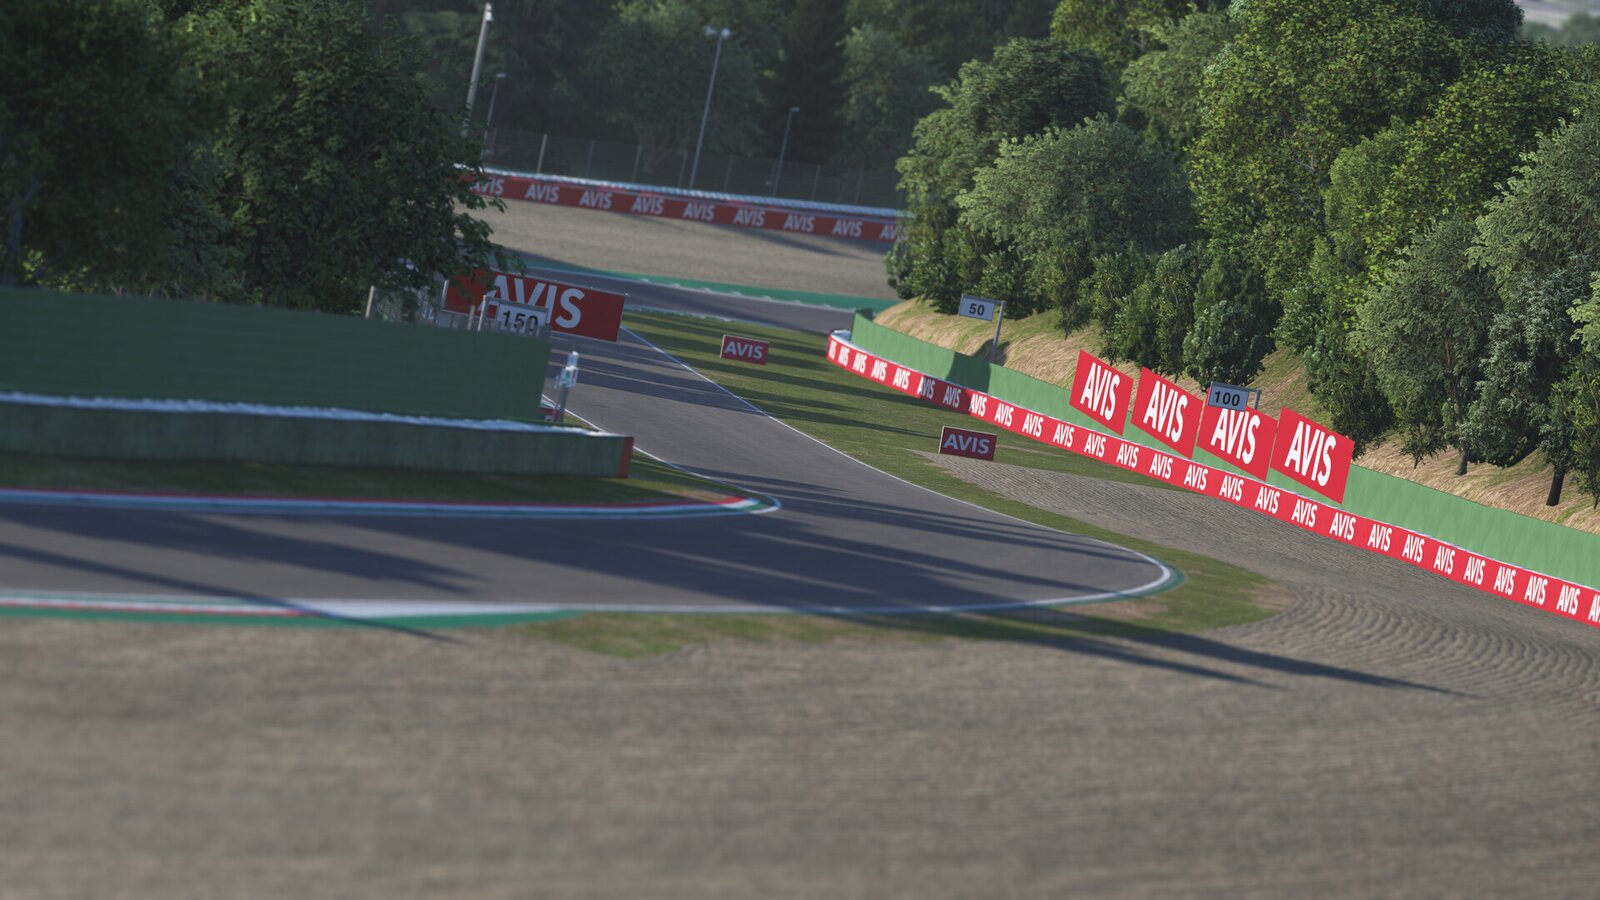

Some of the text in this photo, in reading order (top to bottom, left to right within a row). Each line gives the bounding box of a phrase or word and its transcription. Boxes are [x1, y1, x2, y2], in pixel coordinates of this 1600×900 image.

[525, 184, 560, 202] AVIS
[579, 190, 612, 209] AVIS
[631, 196, 665, 215] AVIS
[683, 202, 715, 221] AVIS
[733, 207, 765, 226] AVIS
[783, 214, 815, 232] AVIS
[832, 219, 863, 237] AVIS
[477, 275, 585, 329] AVIS
[969, 303, 985, 316] 50
[724, 341, 764, 359] AVIS
[1080, 362, 1121, 421] AVIS
[1143, 380, 1188, 443] AVIS
[1214, 390, 1241, 407] 100
[944, 433, 990, 455] AVIS
[1210, 408, 1261, 465] AVIS
[1284, 420, 1337, 487] AVIS
[871, 359, 888, 381] AVIS
[893, 367, 911, 390] AVIS
[917, 376, 935, 399] AVIS
[943, 385, 962, 408] AVIS
[968, 393, 987, 416] AVIS
[994, 402, 1014, 427] AVIS
[1022, 413, 1044, 437] AVIS
[1052, 423, 1075, 447] AVIS
[1084, 433, 1106, 458] AVIS
[1116, 443, 1139, 468] AVIS
[1149, 453, 1173, 479] AVIS
[1184, 464, 1208, 490] AVIS
[1219, 475, 1244, 501] AVIS
[1255, 486, 1280, 514] AVIS
[1291, 499, 1318, 528] AVIS
[1329, 512, 1356, 540] AVIS
[1367, 523, 1393, 552] AVIS
[1402, 534, 1425, 563] AVIS
[1433, 545, 1456, 574] AVIS
[1463, 556, 1486, 585] AVIS
[1493, 565, 1516, 595] AVIS
[1524, 575, 1548, 605] AVIS
[1556, 584, 1581, 616] AVIS
[1588, 594, 1600, 624] AV
